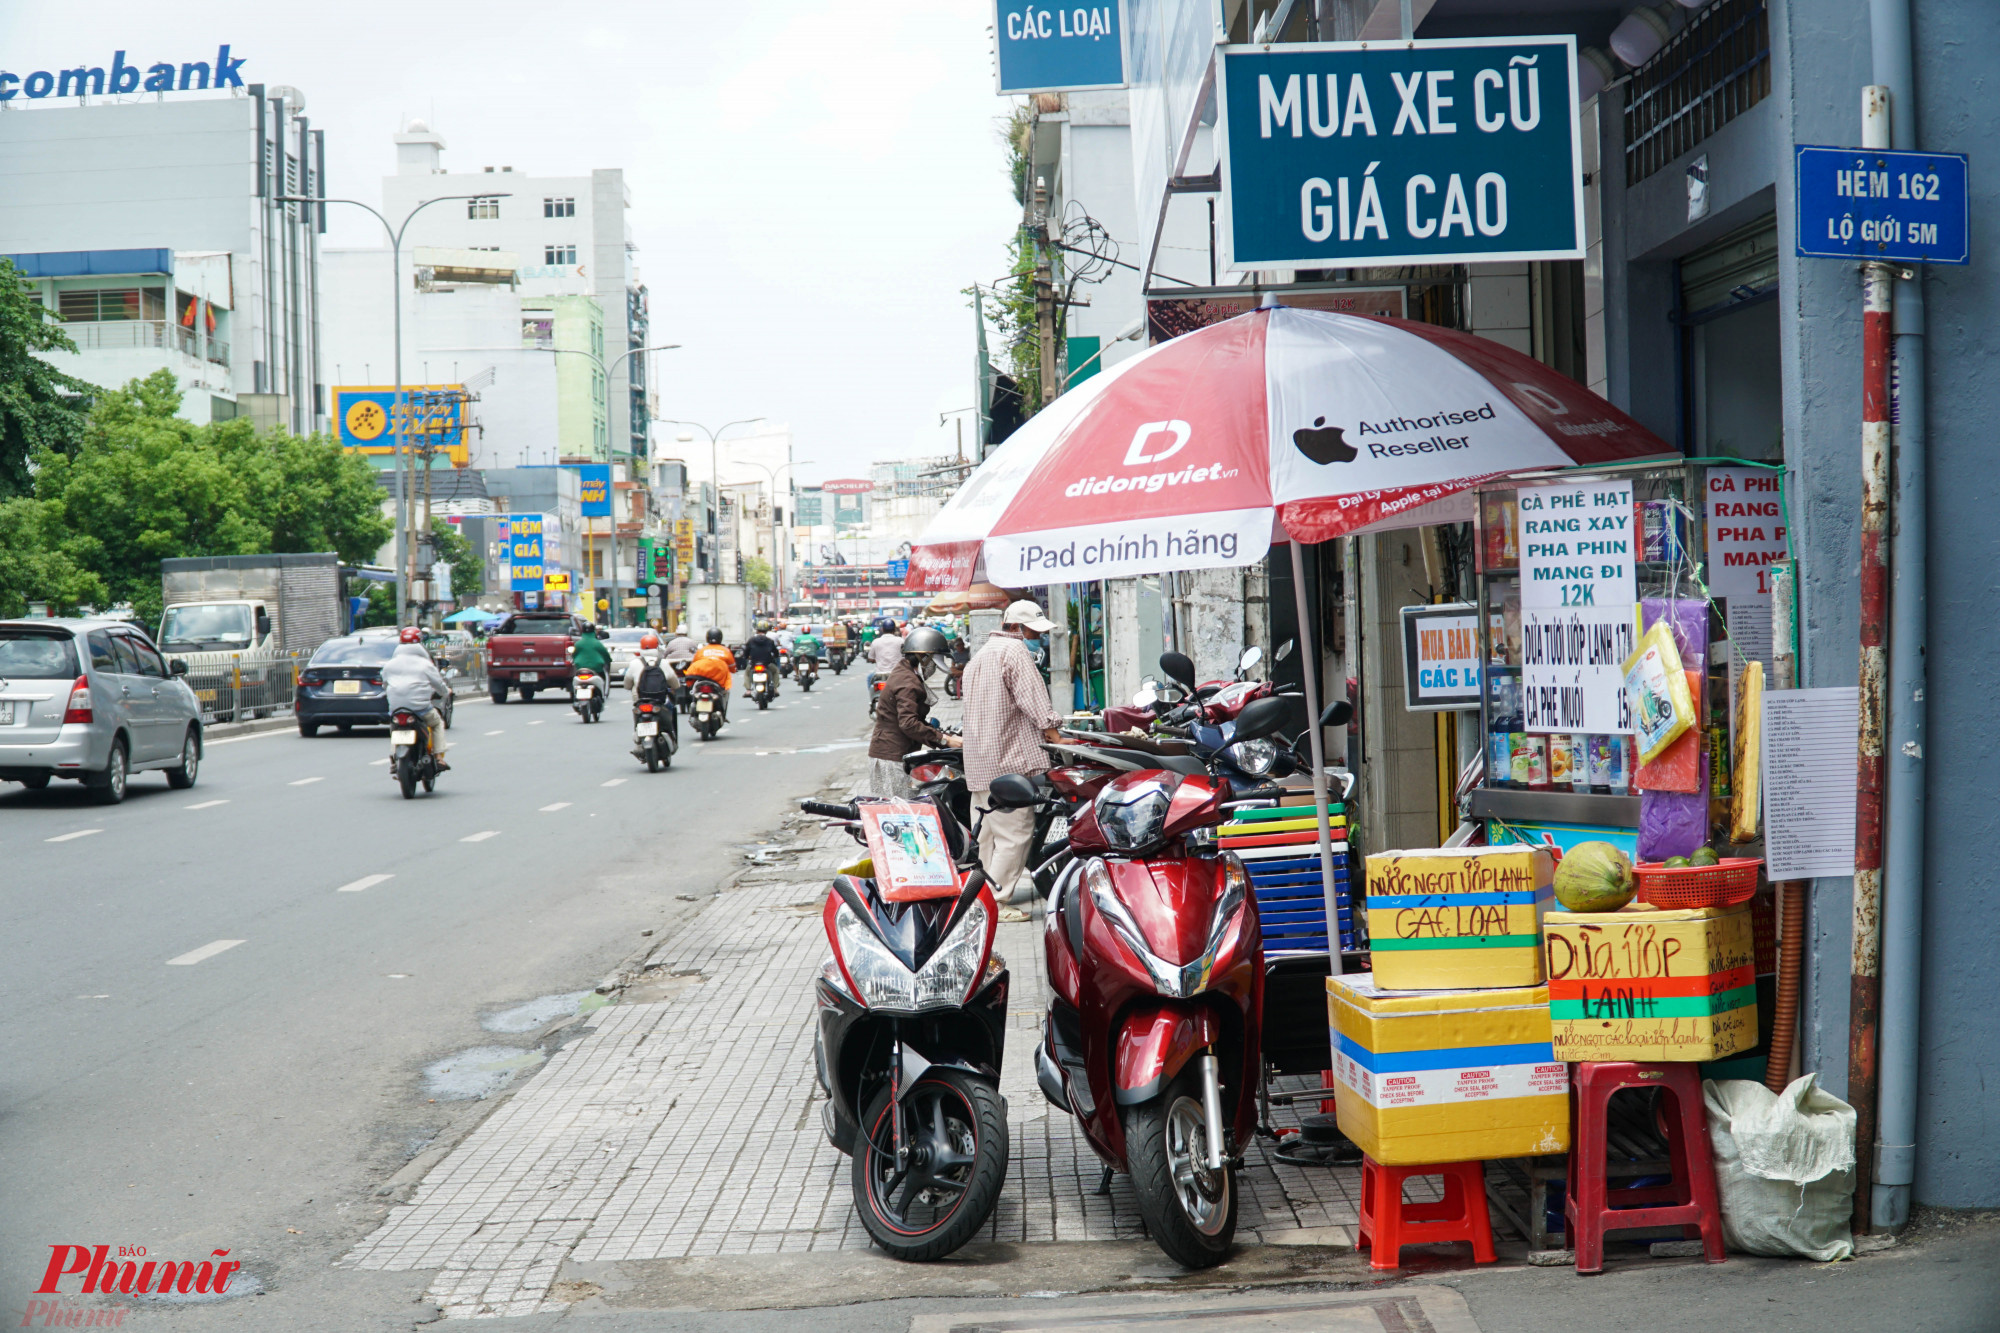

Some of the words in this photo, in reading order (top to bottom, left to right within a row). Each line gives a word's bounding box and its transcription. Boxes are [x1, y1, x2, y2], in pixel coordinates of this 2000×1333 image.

[1007, 6, 1052, 41] CÁC
[1059, 4, 1112, 41] LOẠI
[1258, 73, 1377, 139] MUA
[1390, 69, 1457, 136] XE
[1473, 53, 1541, 133] CŨ
[1837, 159, 1889, 198] HẺM
[1898, 173, 1940, 201] 162
[1301, 161, 1389, 242] GIÁ
[1405, 171, 1508, 240] CAO
[1828, 213, 1853, 245] LỘ
[1861, 215, 1900, 243] GIỚI
[1908, 222, 1937, 245] 5M
[1359, 402, 1496, 436] Authorised
[1367, 434, 1471, 459] Reseller
[1710, 474, 1735, 492] CÀ
[1380, 491, 1421, 514] Apple
[1424, 486, 1442, 498] tại
[1521, 493, 1543, 511] CÀ
[1551, 490, 1586, 509] PHÊ
[1594, 491, 1630, 508] HẠT
[1715, 502, 1779, 517] RANG
[511, 517, 542, 538] NỆM
[1526, 518, 1580, 534] RANG
[1588, 515, 1628, 531] XAY
[1717, 527, 1765, 542] PHA
[514, 539, 540, 557] GIÁ
[1019, 541, 1075, 572] iPad
[1083, 533, 1159, 563] chính
[1166, 529, 1238, 559] hãng
[1528, 543, 1569, 557] PHA
[1577, 540, 1626, 555] PHIN
[512, 565, 542, 579] KHO
[1533, 566, 1594, 580] MANG
[1601, 565, 1622, 578] ĐI
[1561, 583, 1595, 607] 12K
[1420, 629, 1445, 661] MUA
[1447, 620, 1471, 660] BÁN
[1525, 612, 1543, 665] DỪA
[1545, 616, 1565, 665] TƯƠI
[1567, 612, 1585, 665] ƯỚP
[1588, 623, 1613, 675] LẠNH
[1420, 664, 1458, 688] CÁC
[1526, 674, 1538, 726] CÀ
[1541, 675, 1558, 727] PHÊ
[1561, 670, 1584, 728] MUỐI
[1370, 857, 1411, 896] NƯỚC
[1461, 856, 1493, 893] ƯỚP
[1396, 896, 1450, 939] CÁC
[1582, 985, 1659, 1028] LẠNH
[1388, 1077, 1415, 1085] CAUTION
[1462, 1071, 1490, 1079] CAUTION
[1536, 1065, 1563, 1073] CAUTION
